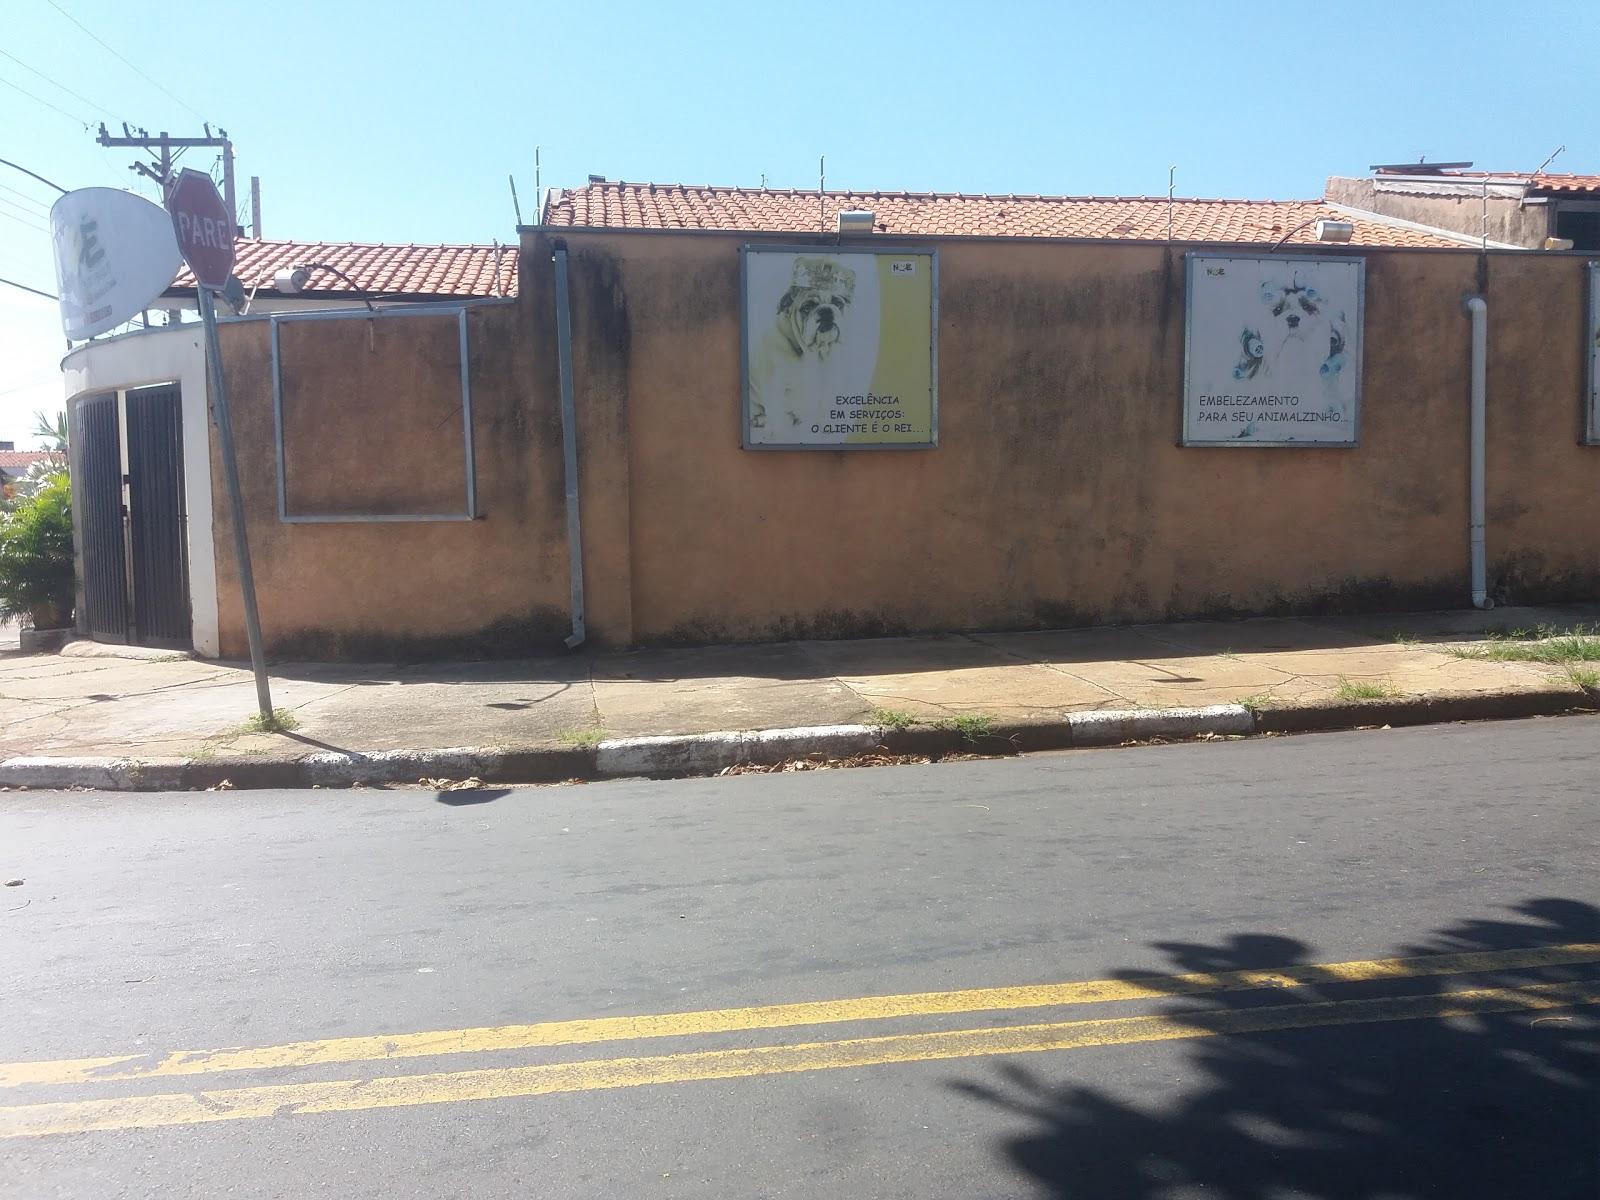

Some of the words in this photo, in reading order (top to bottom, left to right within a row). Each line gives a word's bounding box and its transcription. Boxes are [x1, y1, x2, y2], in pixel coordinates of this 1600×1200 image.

[178, 211, 230, 250] PARE
[835, 393, 900, 406] EXCELÊNCIA
[1199, 394, 1299, 407] EMBELEZAMENTO
[830, 409, 846, 420] EM
[849, 409, 905, 421] SERVIÇOS:
[1198, 411, 1228, 422] PARA
[1231, 411, 1253, 422] SEU
[811, 424, 819, 434] O
[823, 424, 868, 434] CLIENTE
[871, 420, 878, 433] É
[882, 424, 890, 433] O
